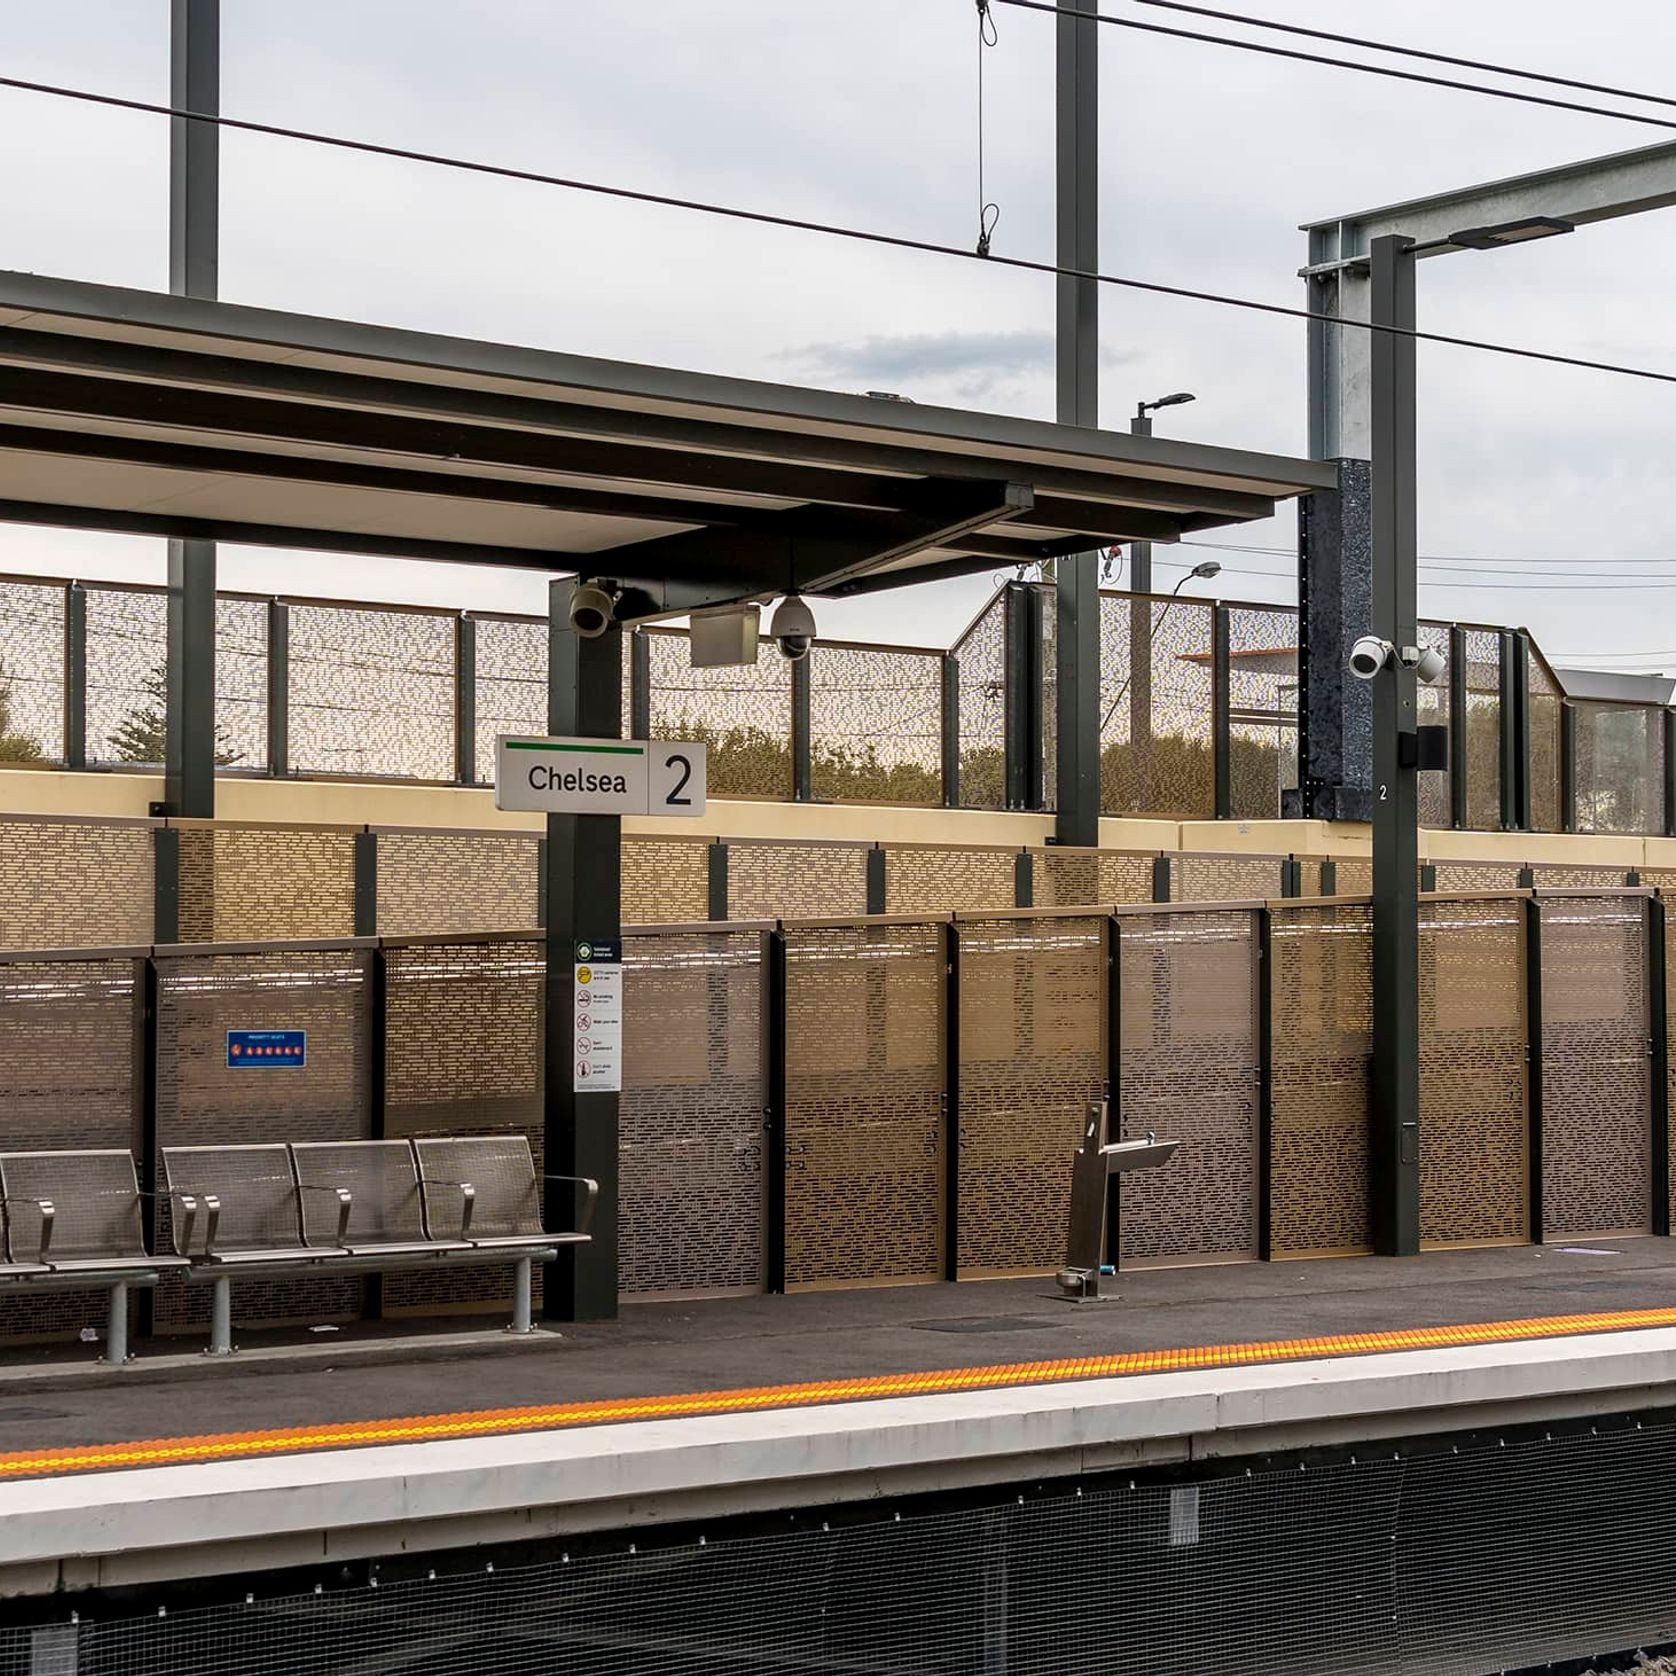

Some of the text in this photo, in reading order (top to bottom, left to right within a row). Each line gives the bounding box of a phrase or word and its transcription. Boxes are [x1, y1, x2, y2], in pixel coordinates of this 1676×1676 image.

[528, 765, 627, 794] Chelsea
[665, 754, 692, 806] 2
[1379, 784, 1387, 800] 2
